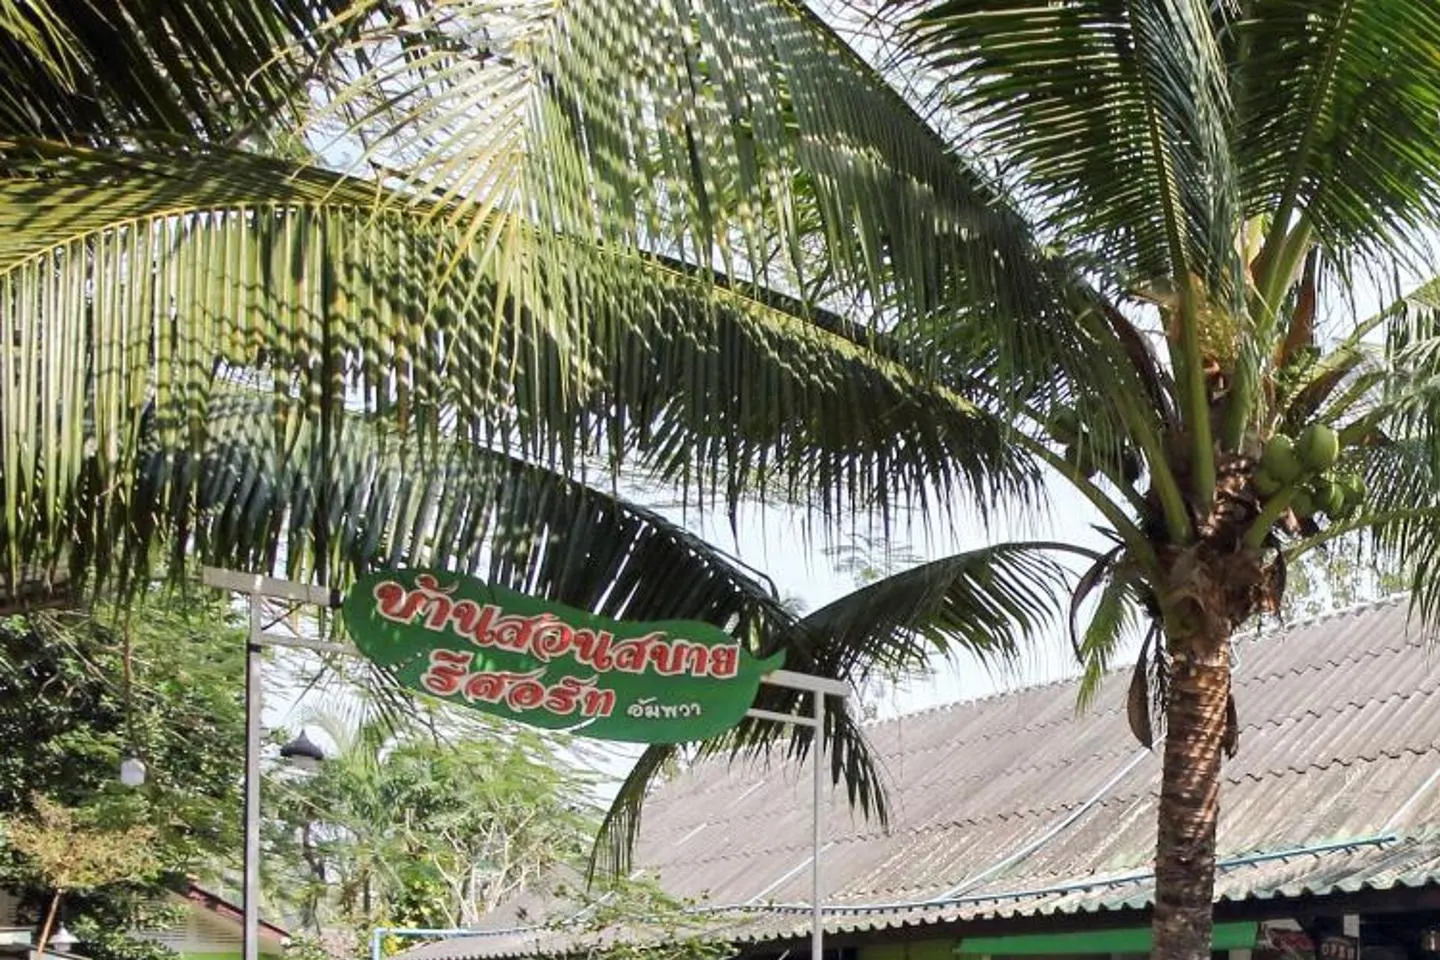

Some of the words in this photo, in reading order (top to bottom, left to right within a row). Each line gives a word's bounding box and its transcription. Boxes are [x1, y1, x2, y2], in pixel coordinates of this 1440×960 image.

[422, 649, 617, 717] รีสอร์ท
[626, 697, 702, 718] อัมพวา
